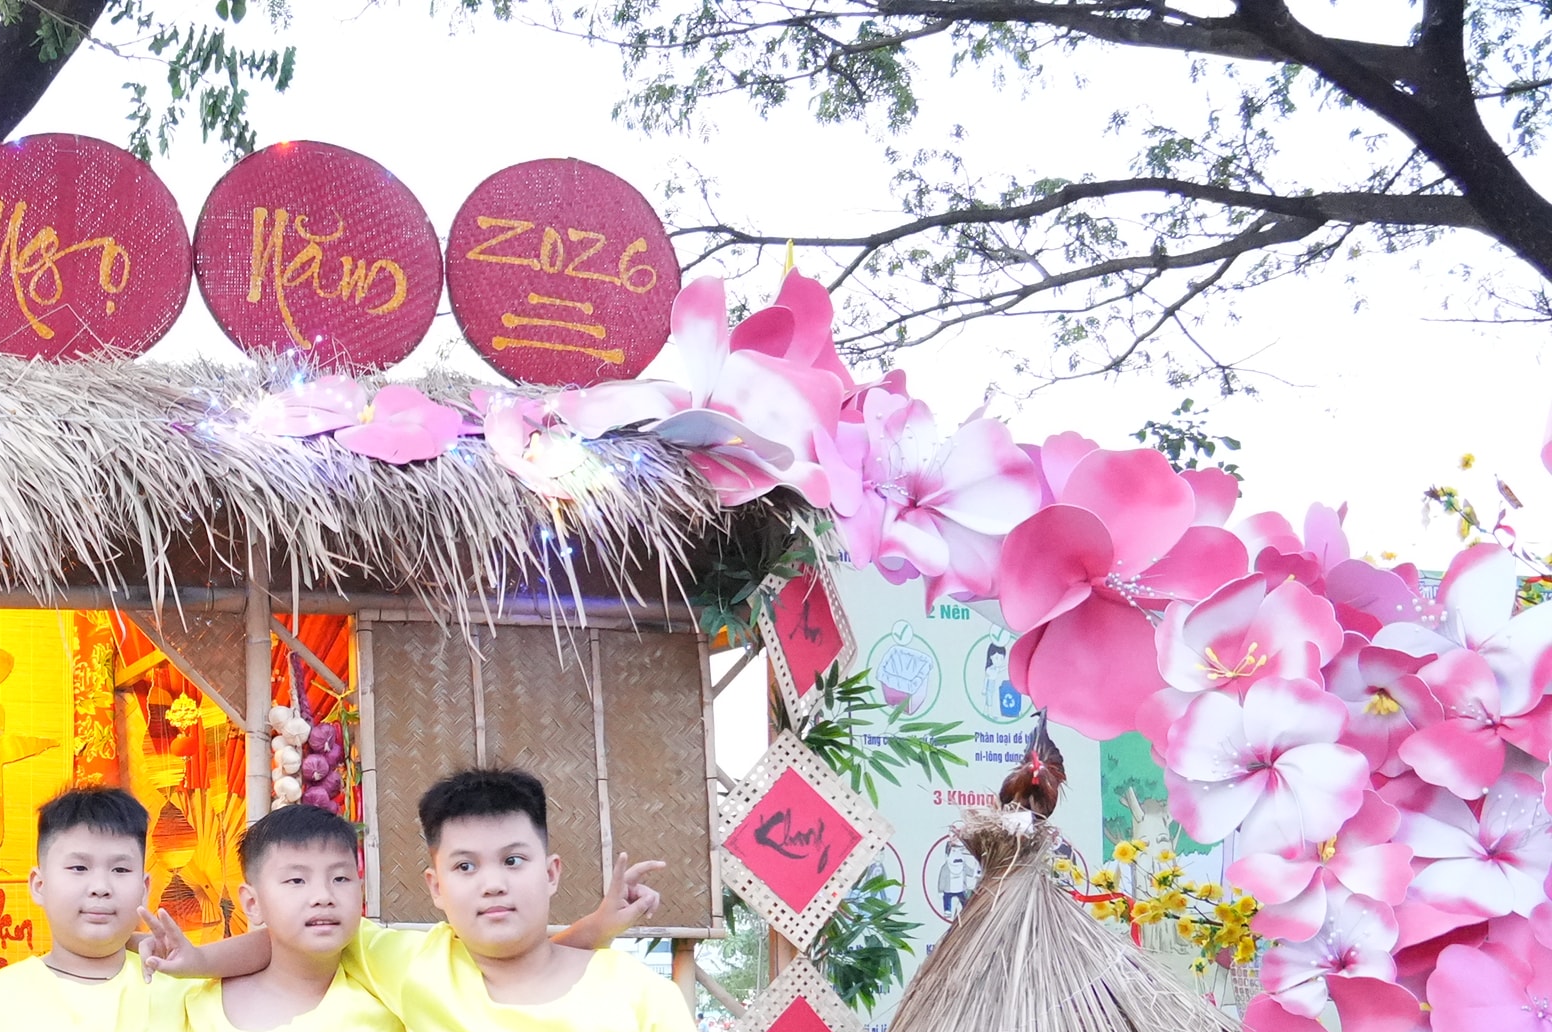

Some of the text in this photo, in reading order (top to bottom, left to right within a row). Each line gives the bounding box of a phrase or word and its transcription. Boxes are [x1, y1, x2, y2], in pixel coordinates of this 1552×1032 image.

[247, 206, 407, 350] Năm
[465, 214, 658, 294] 2026
[940, 604, 970, 620] Nên
[933, 789, 942, 806] 3
